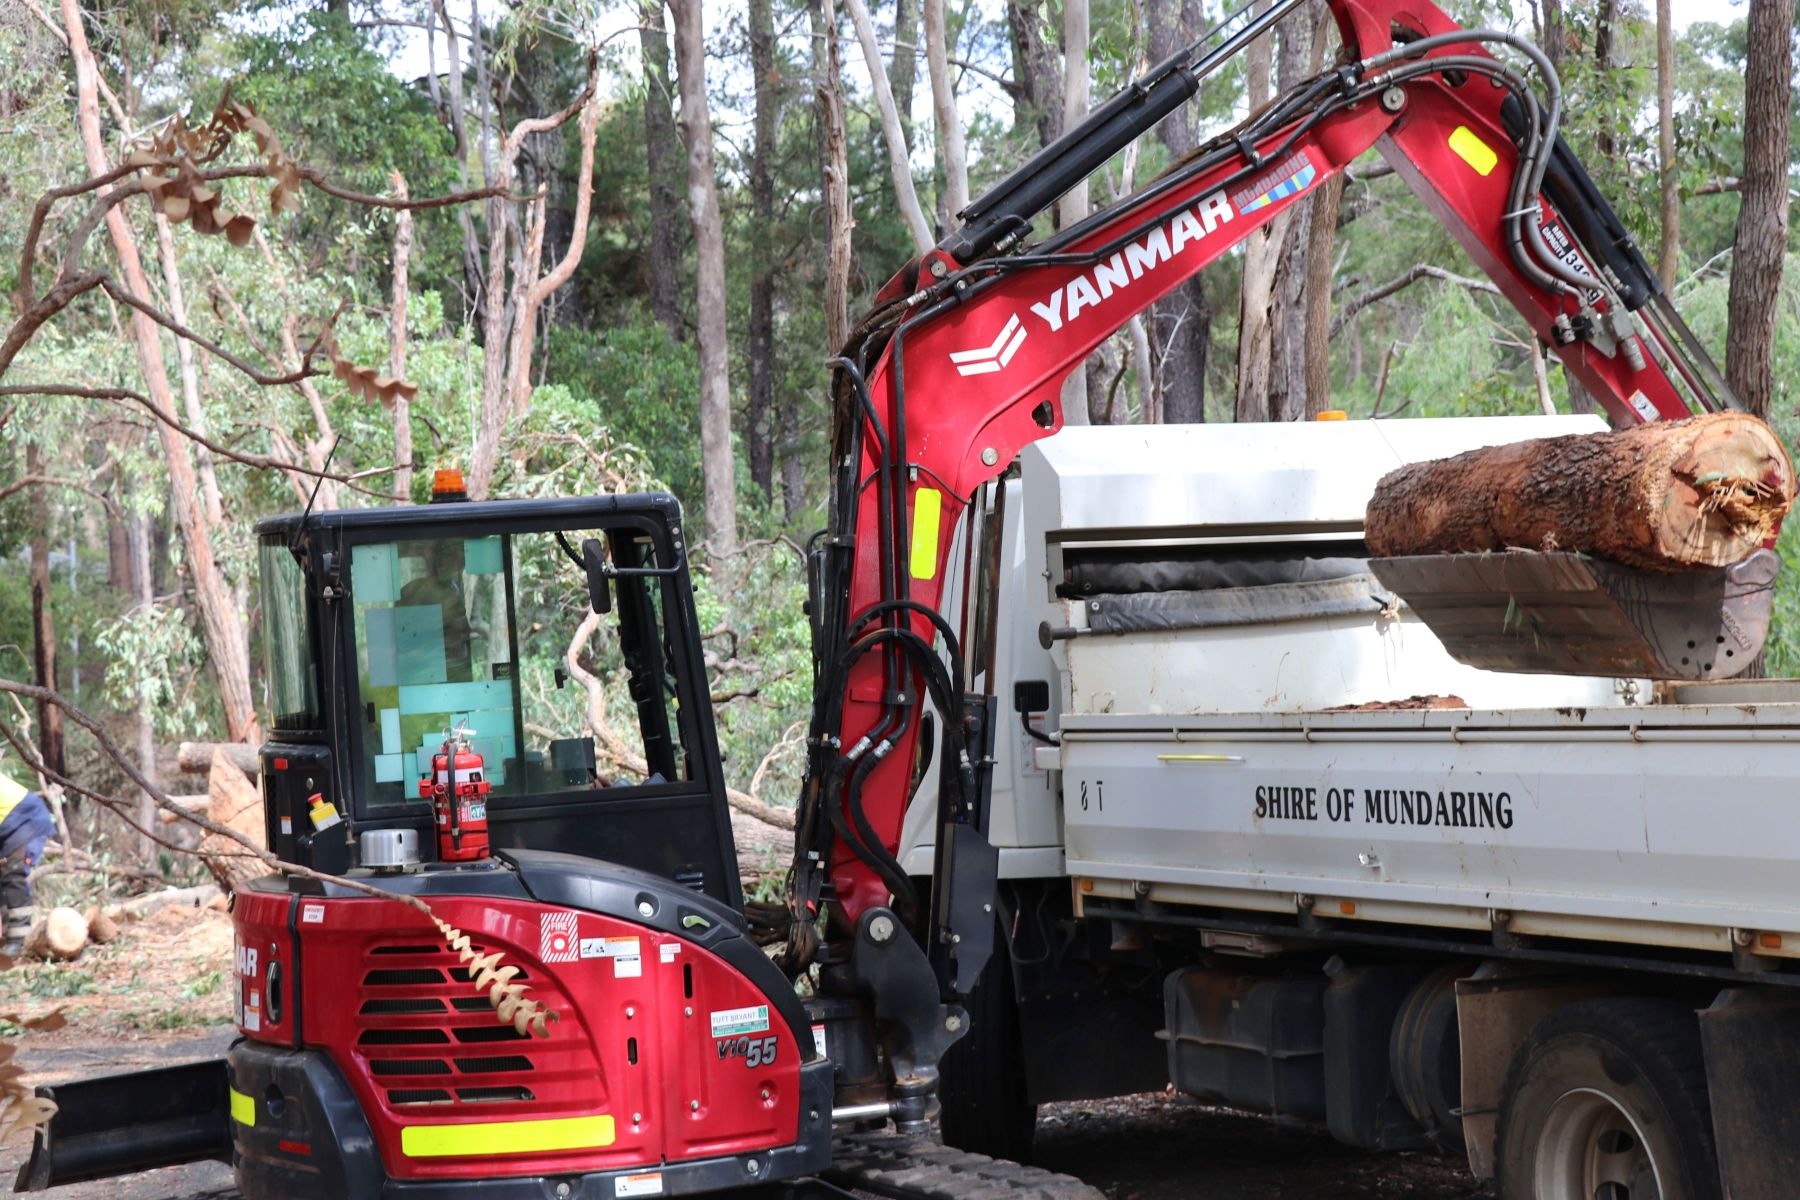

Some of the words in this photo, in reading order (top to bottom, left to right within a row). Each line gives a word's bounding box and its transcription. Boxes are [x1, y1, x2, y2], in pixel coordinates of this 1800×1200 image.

[1030, 190, 1234, 332] YANMAR
[1255, 785, 1318, 820] SHIRE
[1326, 787, 1355, 822] OF
[1364, 789, 1514, 829] MUNDARING
[551, 921, 568, 931] FIRE
